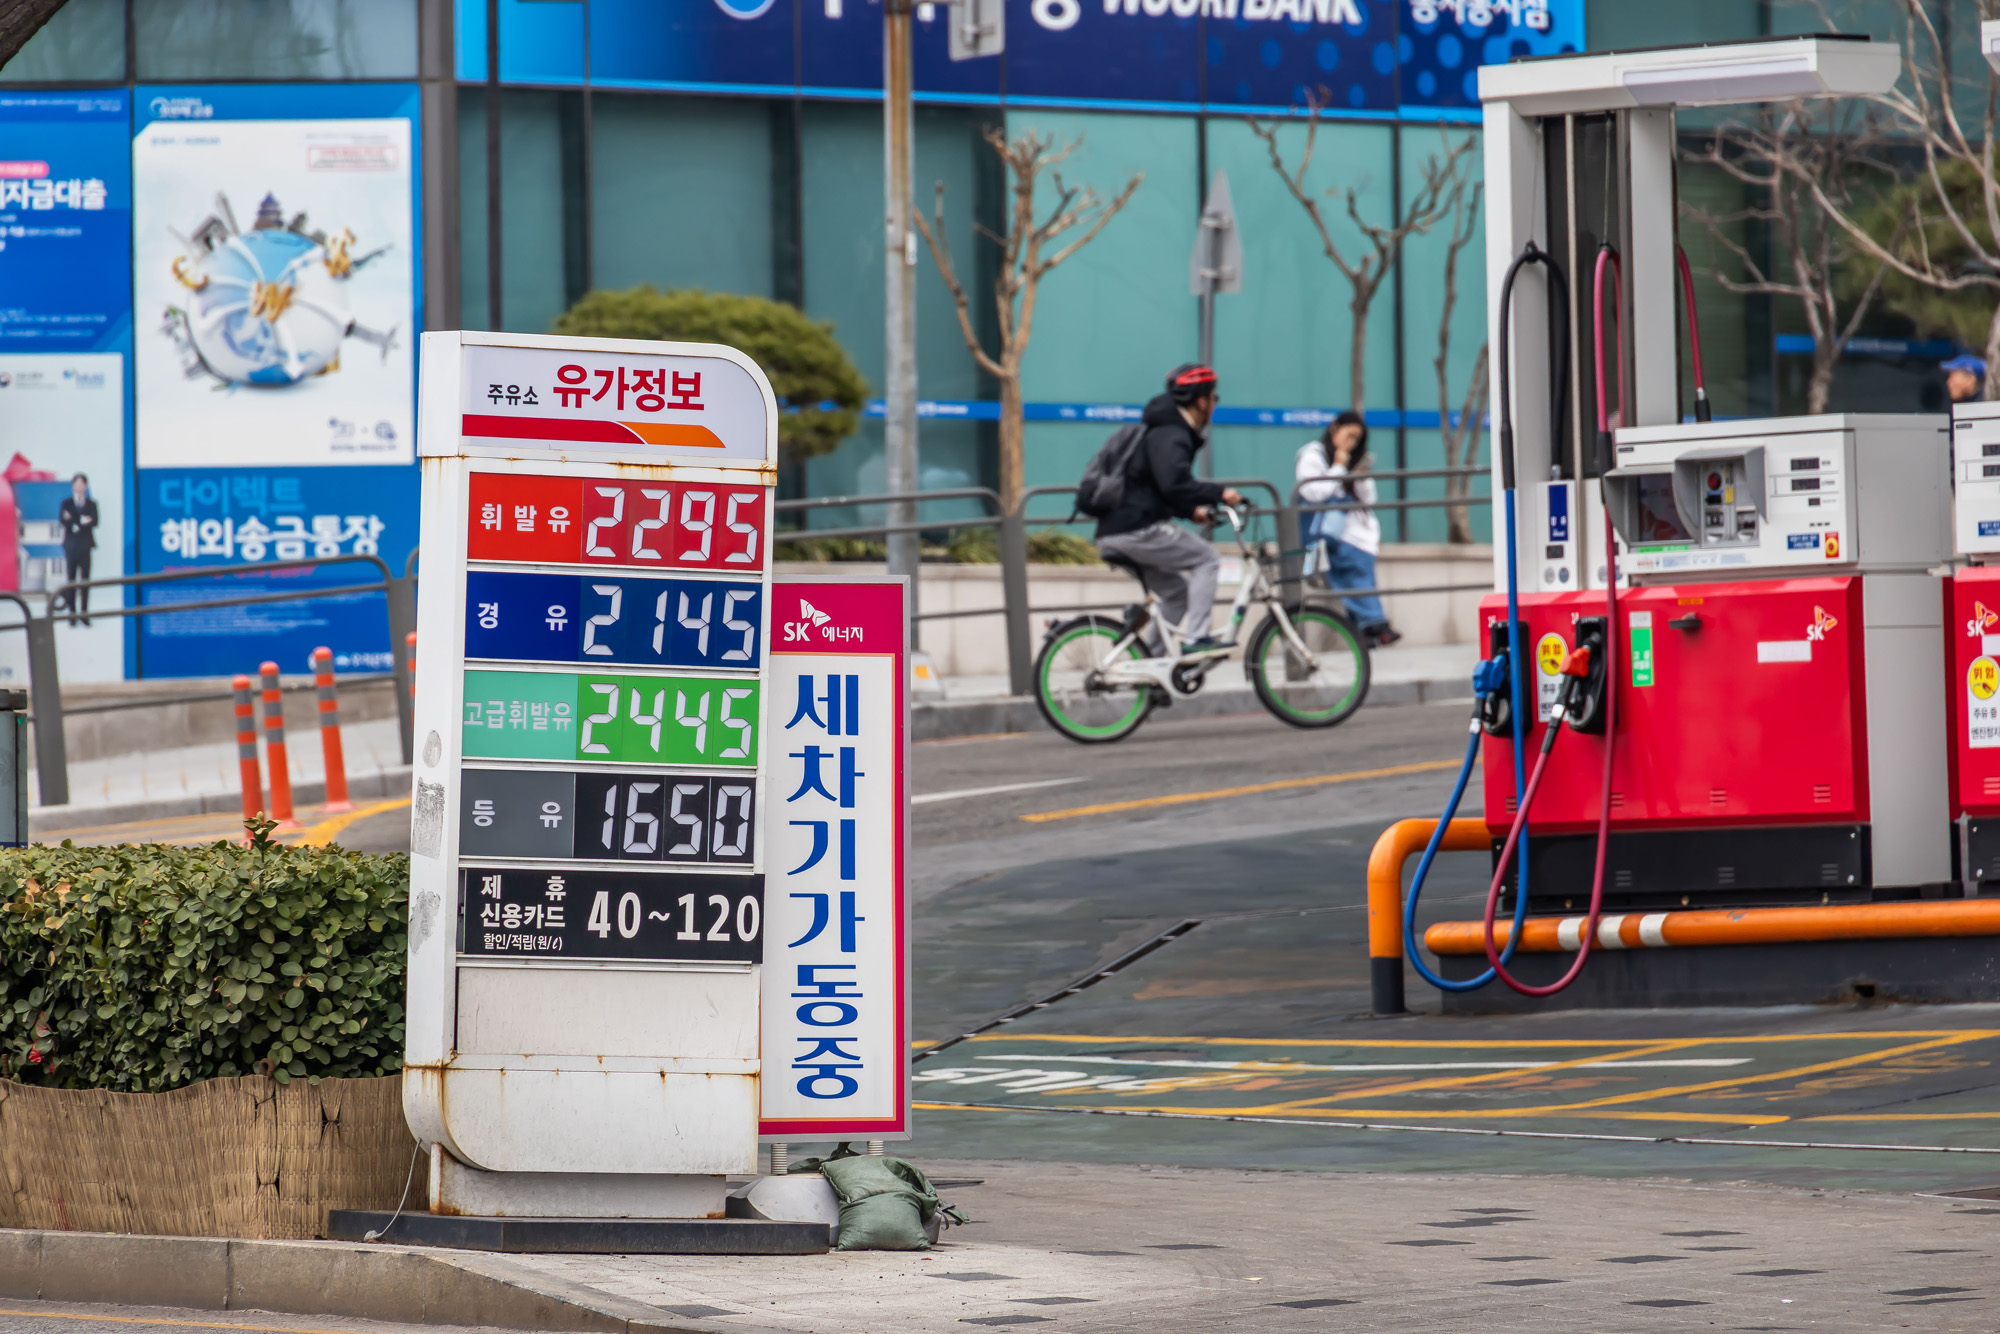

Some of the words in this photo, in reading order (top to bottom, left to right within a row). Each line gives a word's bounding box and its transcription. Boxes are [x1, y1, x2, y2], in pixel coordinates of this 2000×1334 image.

[487, 383, 539, 406] 주유소
[552, 363, 705, 413] 유가정보
[159, 475, 306, 517] 다이렉트
[160, 513, 386, 561] 해외송금통장
[585, 486, 760, 564] 2295
[582, 584, 757, 662] 2145
[783, 622, 811, 643] SK
[821, 625, 864, 643] 에너지
[1806, 624, 1825, 641] SK
[1967, 619, 1985, 638] SK
[463, 700, 573, 732] 고급휘발유
[580, 682, 754, 759] 2445
[601, 781, 753, 857] 1650
[784, 673, 866, 1100] 세차기가동중
[480, 903, 567, 929] 신용카드
